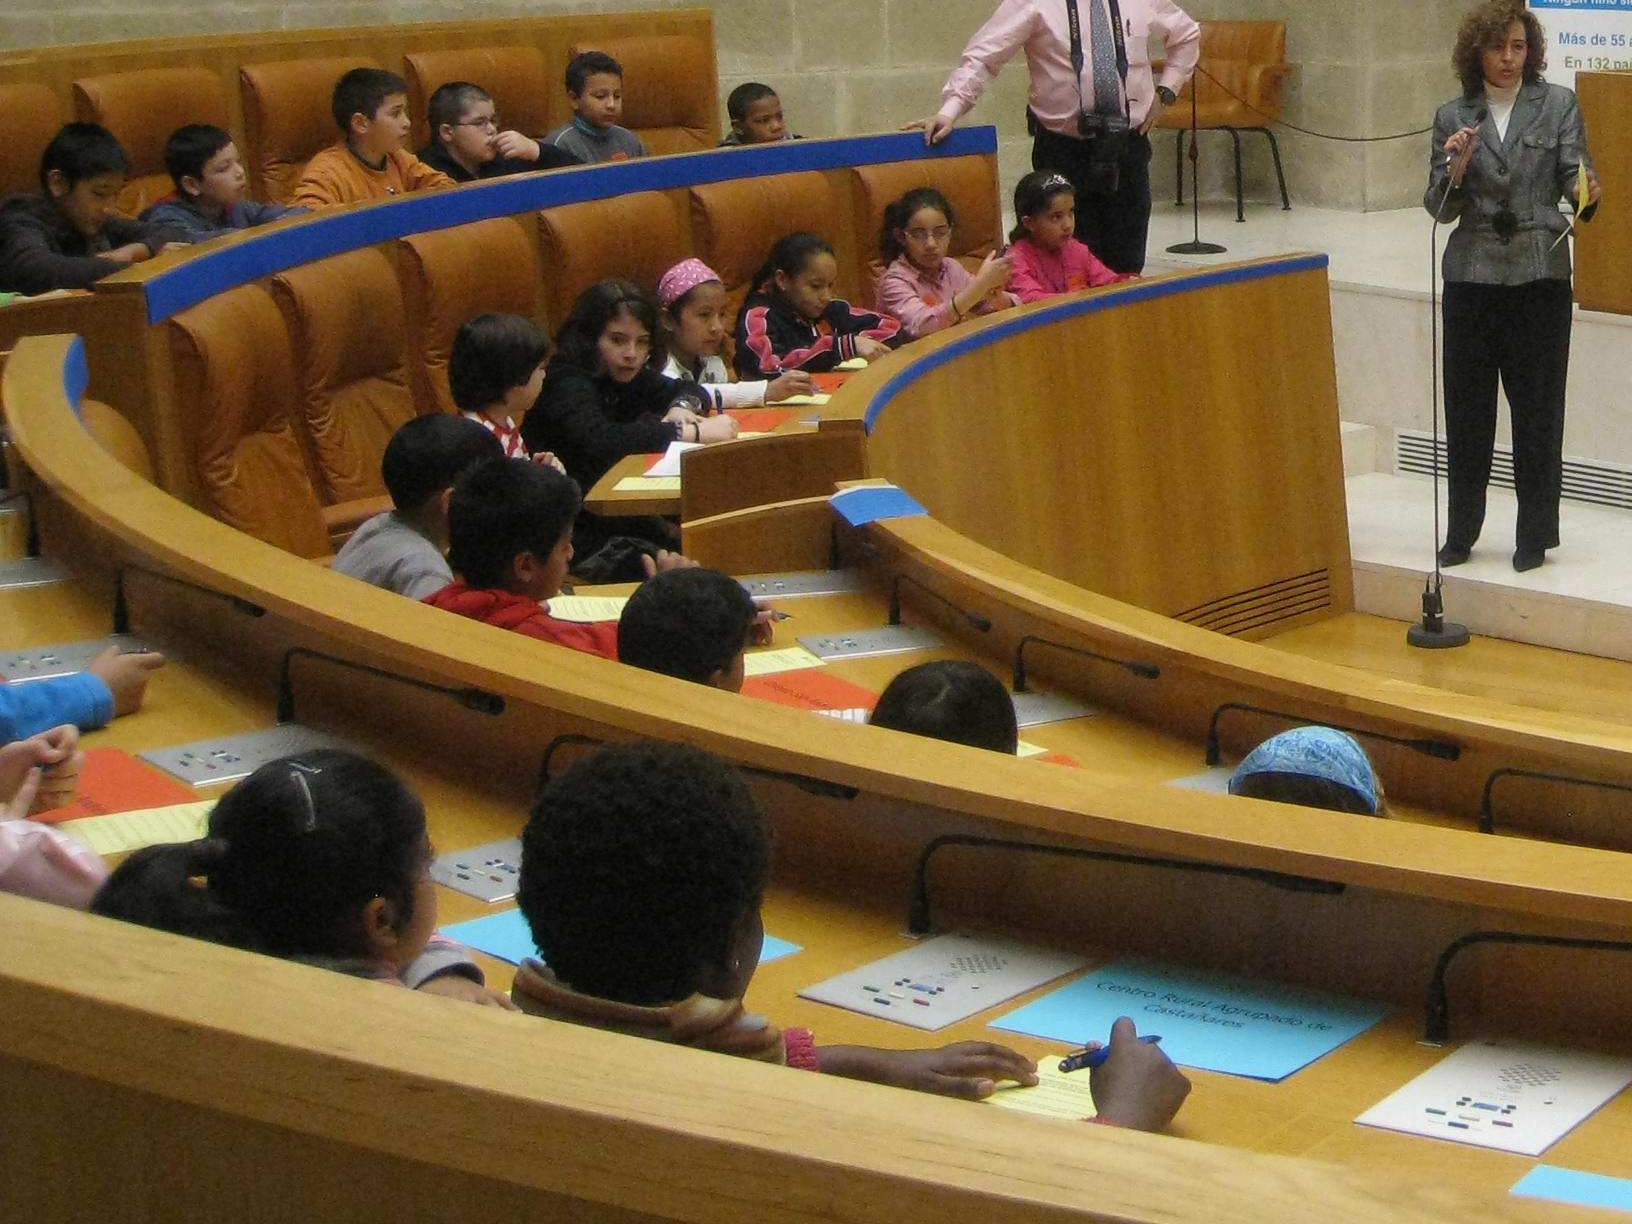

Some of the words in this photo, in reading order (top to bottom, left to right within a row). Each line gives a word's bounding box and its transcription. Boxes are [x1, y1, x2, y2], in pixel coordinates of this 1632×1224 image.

[1558, 32, 1587, 45] Más
[1590, 34, 1607, 46] de
[1611, 34, 1626, 47] 55
[1565, 56, 1582, 68] En
[1587, 57, 1610, 69] 132
[1096, 981, 1158, 999] Centro
[1160, 991, 1210, 1010] Rural
[1212, 999, 1305, 1028] Agrupado
[1306, 1020, 1333, 1032] de
